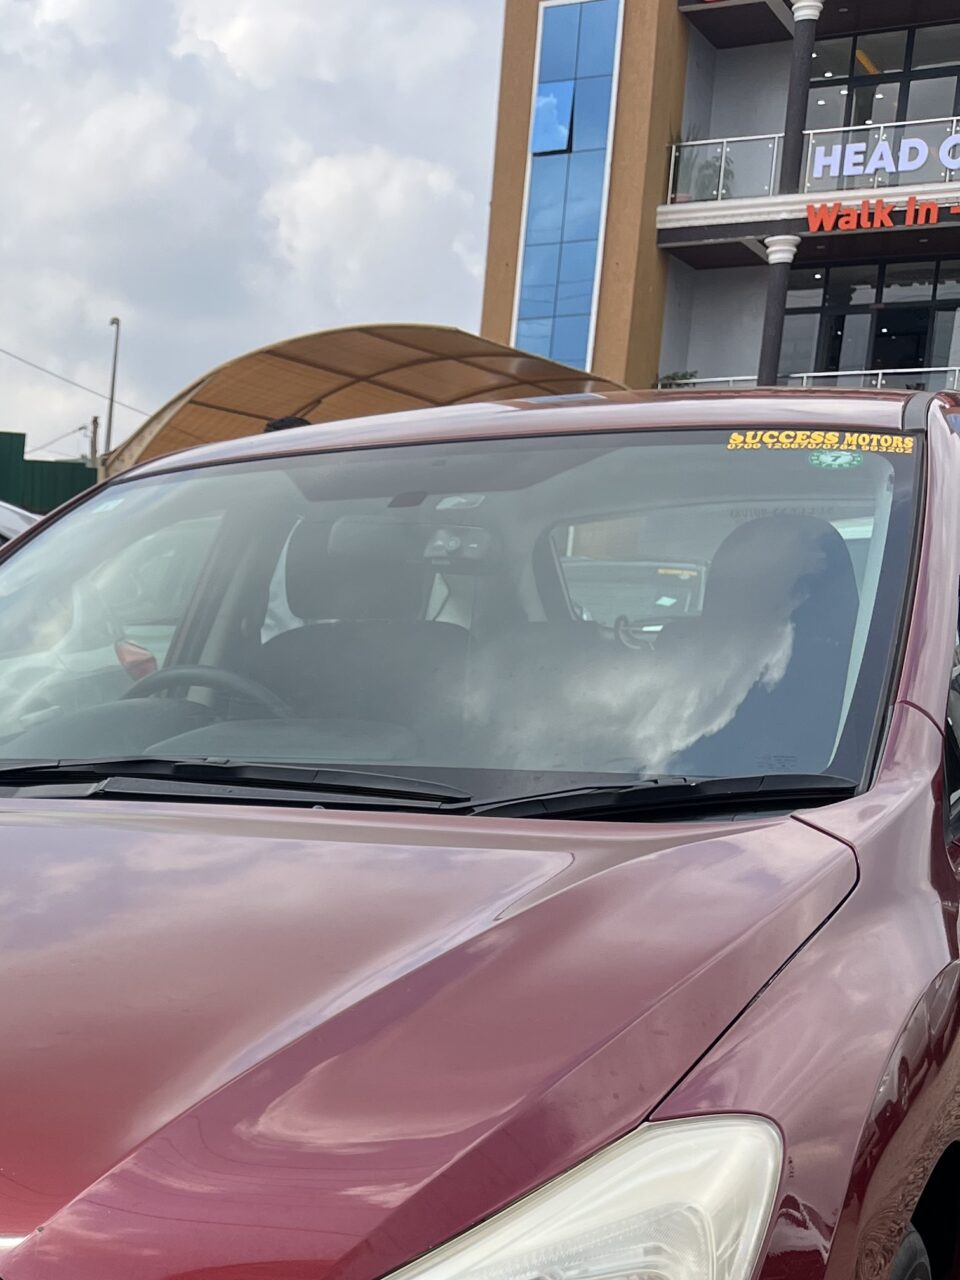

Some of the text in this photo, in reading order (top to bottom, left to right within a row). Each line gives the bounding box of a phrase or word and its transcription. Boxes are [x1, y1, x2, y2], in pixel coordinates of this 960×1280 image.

[812, 137, 929, 178] HEAD
[806, 198, 896, 233] Walk
[904, 196, 939, 227] In
[728, 430, 914, 448] SUCCESS MOTORS
